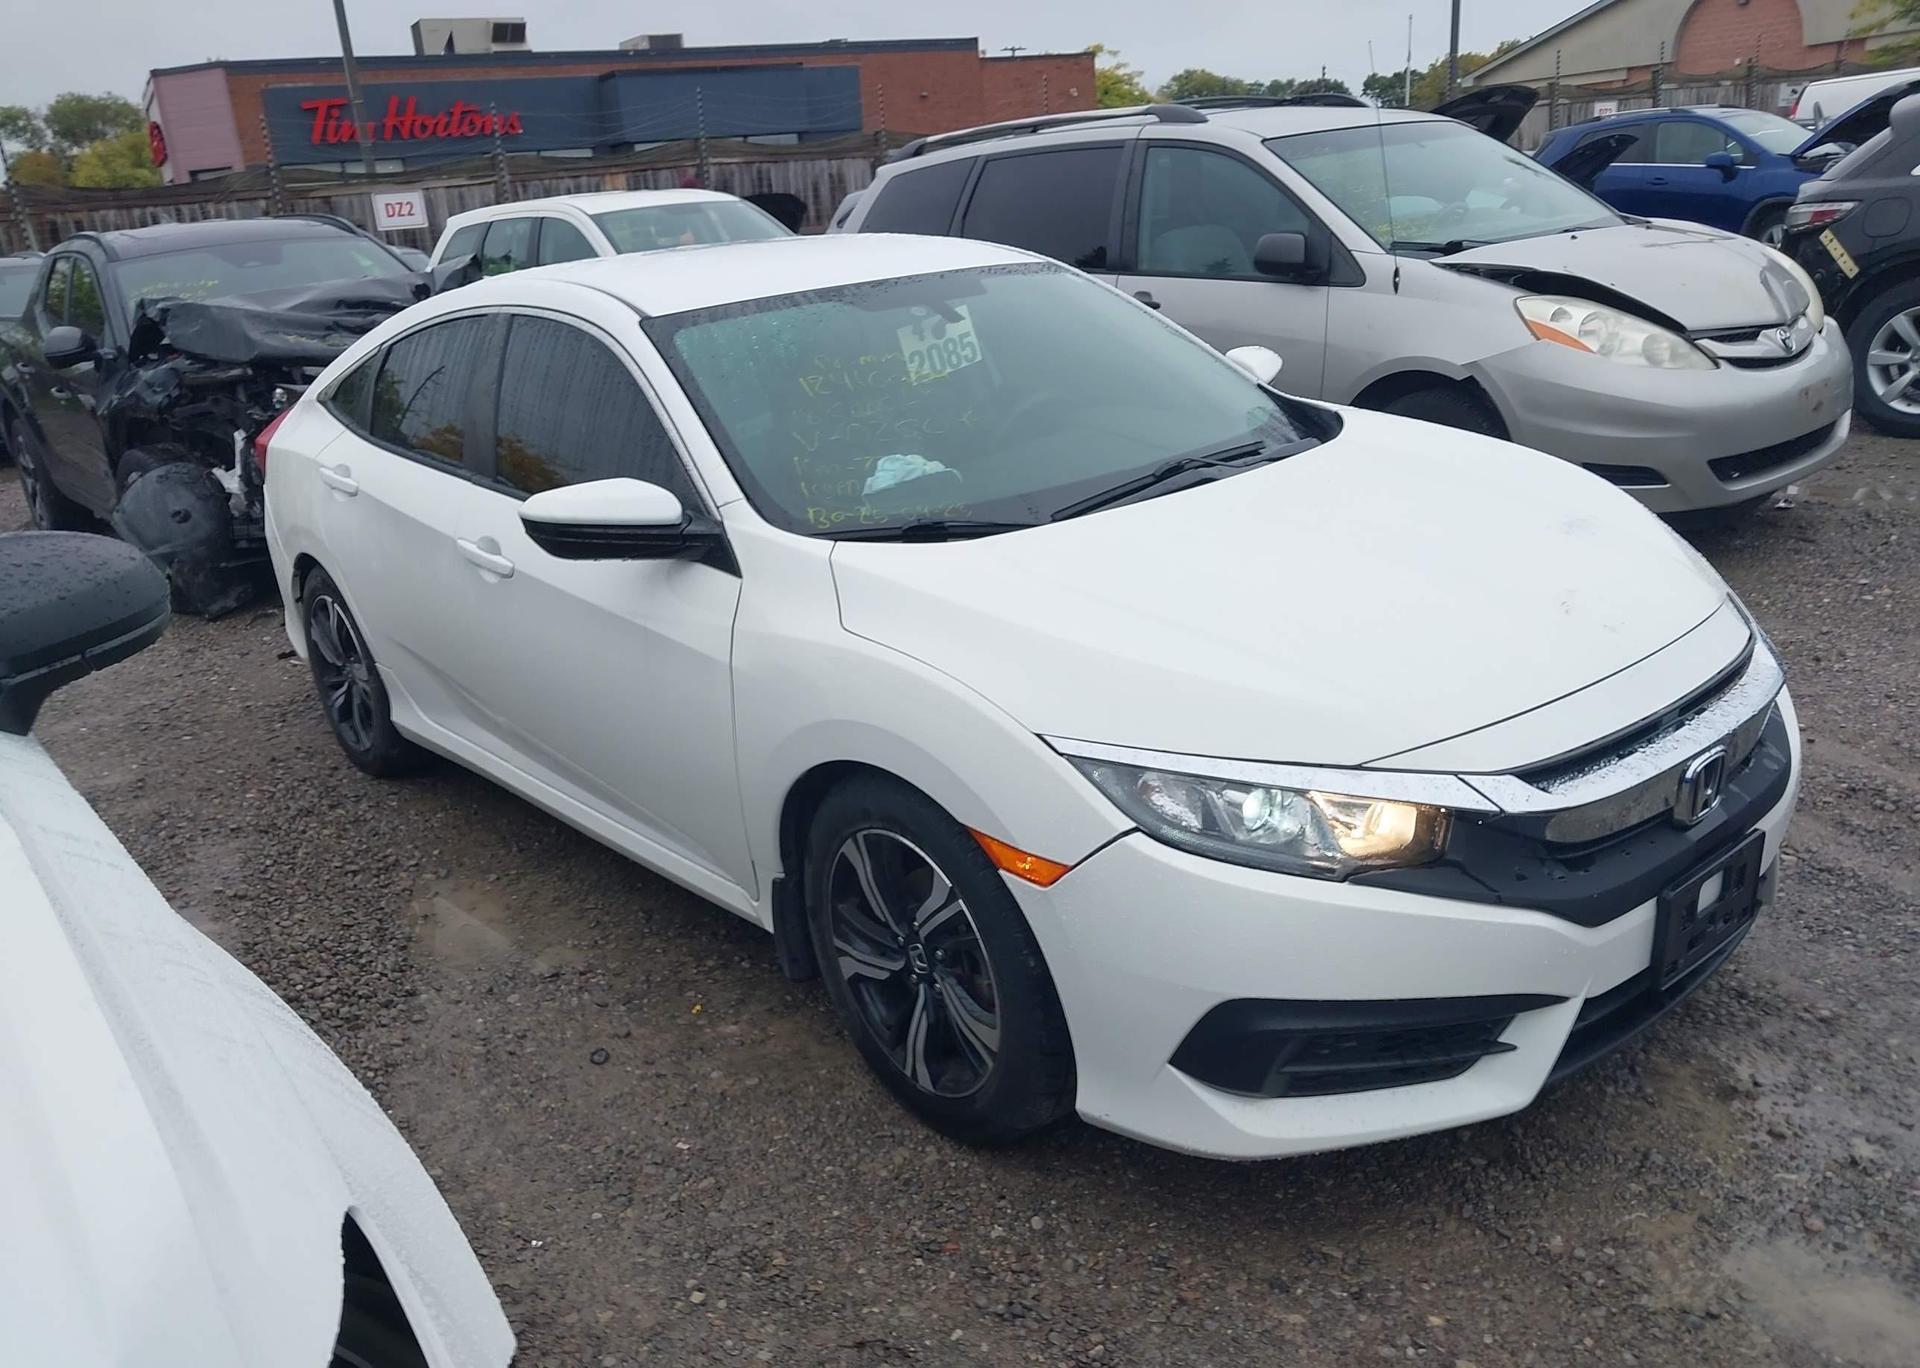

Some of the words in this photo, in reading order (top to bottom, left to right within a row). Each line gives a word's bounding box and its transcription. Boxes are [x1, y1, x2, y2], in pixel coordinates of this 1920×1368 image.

[302, 97, 376, 145] Tim
[383, 95, 524, 140] Hortons
[385, 201, 416, 218] DZ2
[907, 330, 978, 375] 2085
